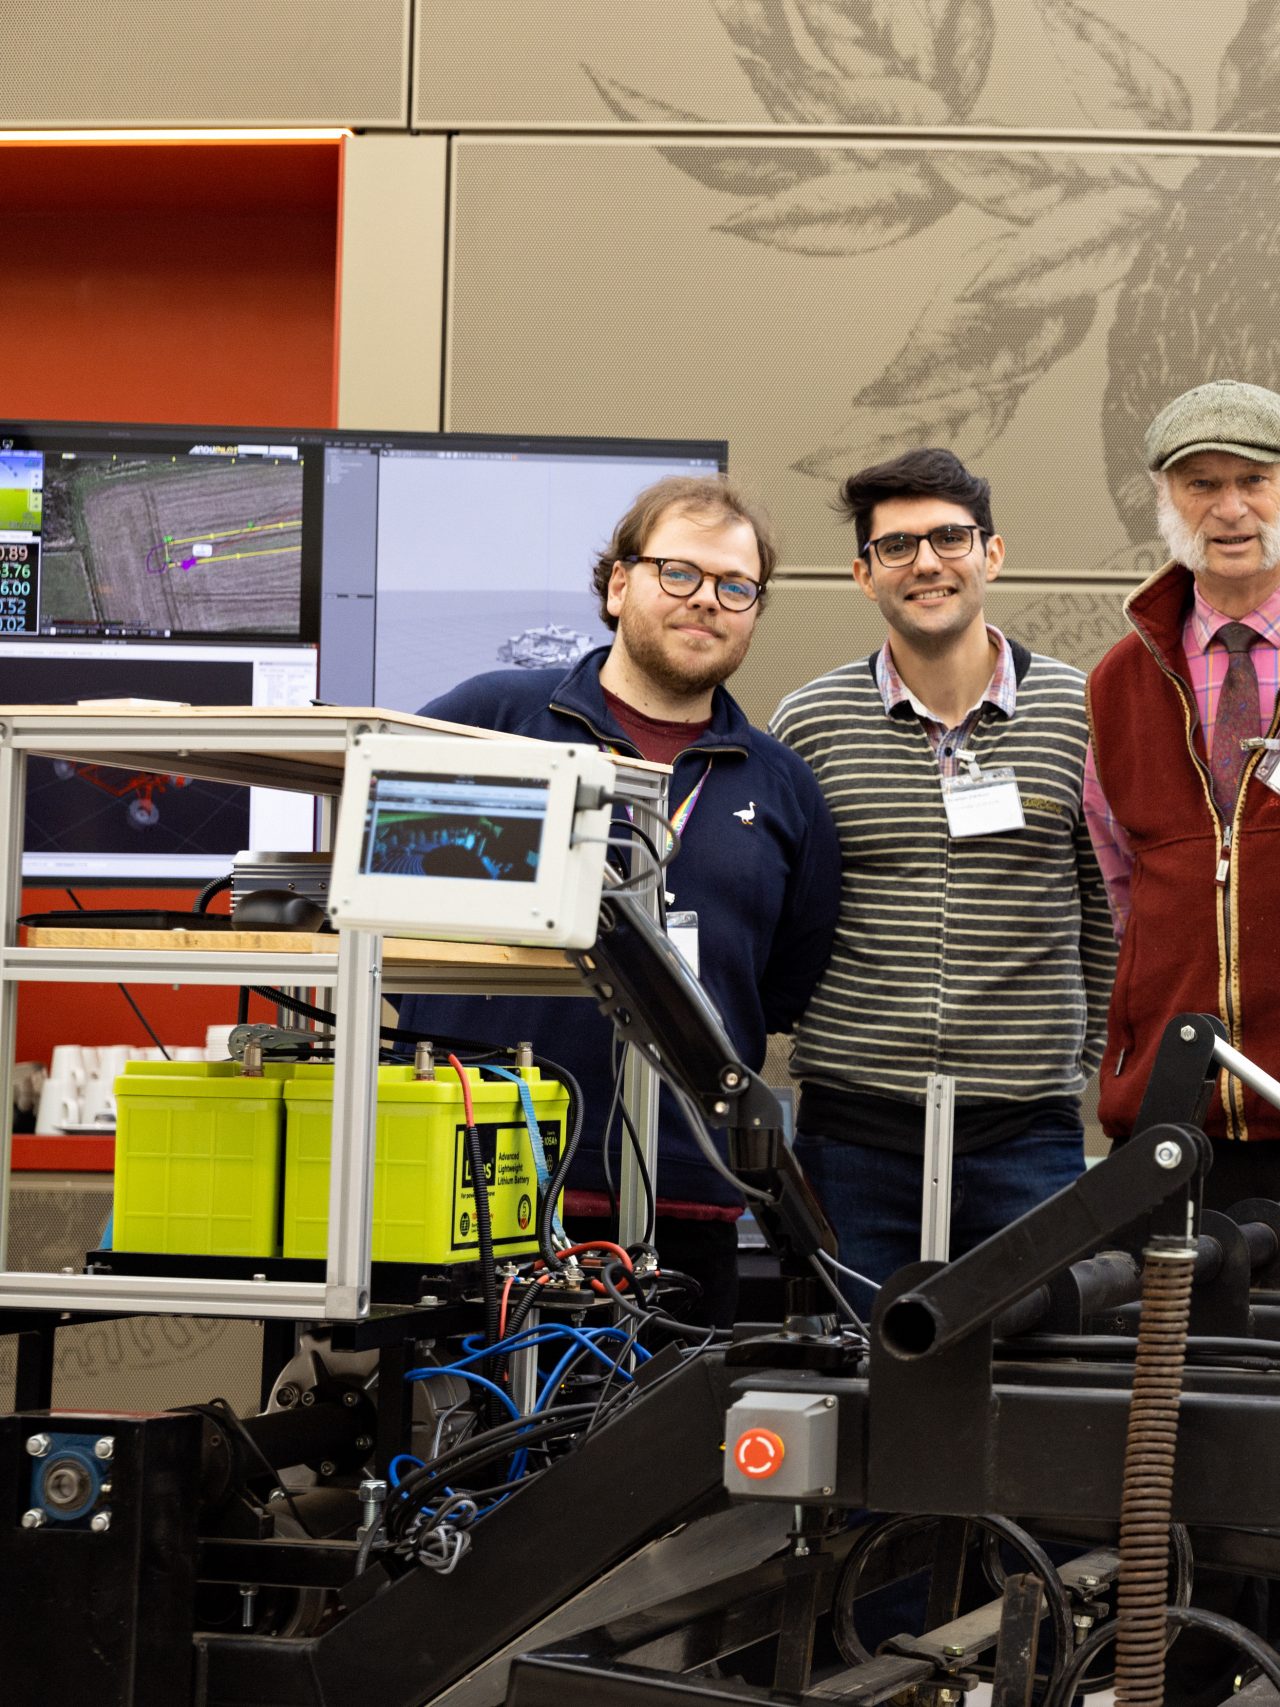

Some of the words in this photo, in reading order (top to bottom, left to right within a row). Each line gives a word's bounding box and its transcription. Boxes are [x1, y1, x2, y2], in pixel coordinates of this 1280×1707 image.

[0, 563, 31, 578] 3.76
[498, 1151, 520, 1161] Advanced
[498, 1163, 524, 1175] Lightweight
[497, 1176, 514, 1186] Lithium
[514, 1175, 530, 1186] Battery
